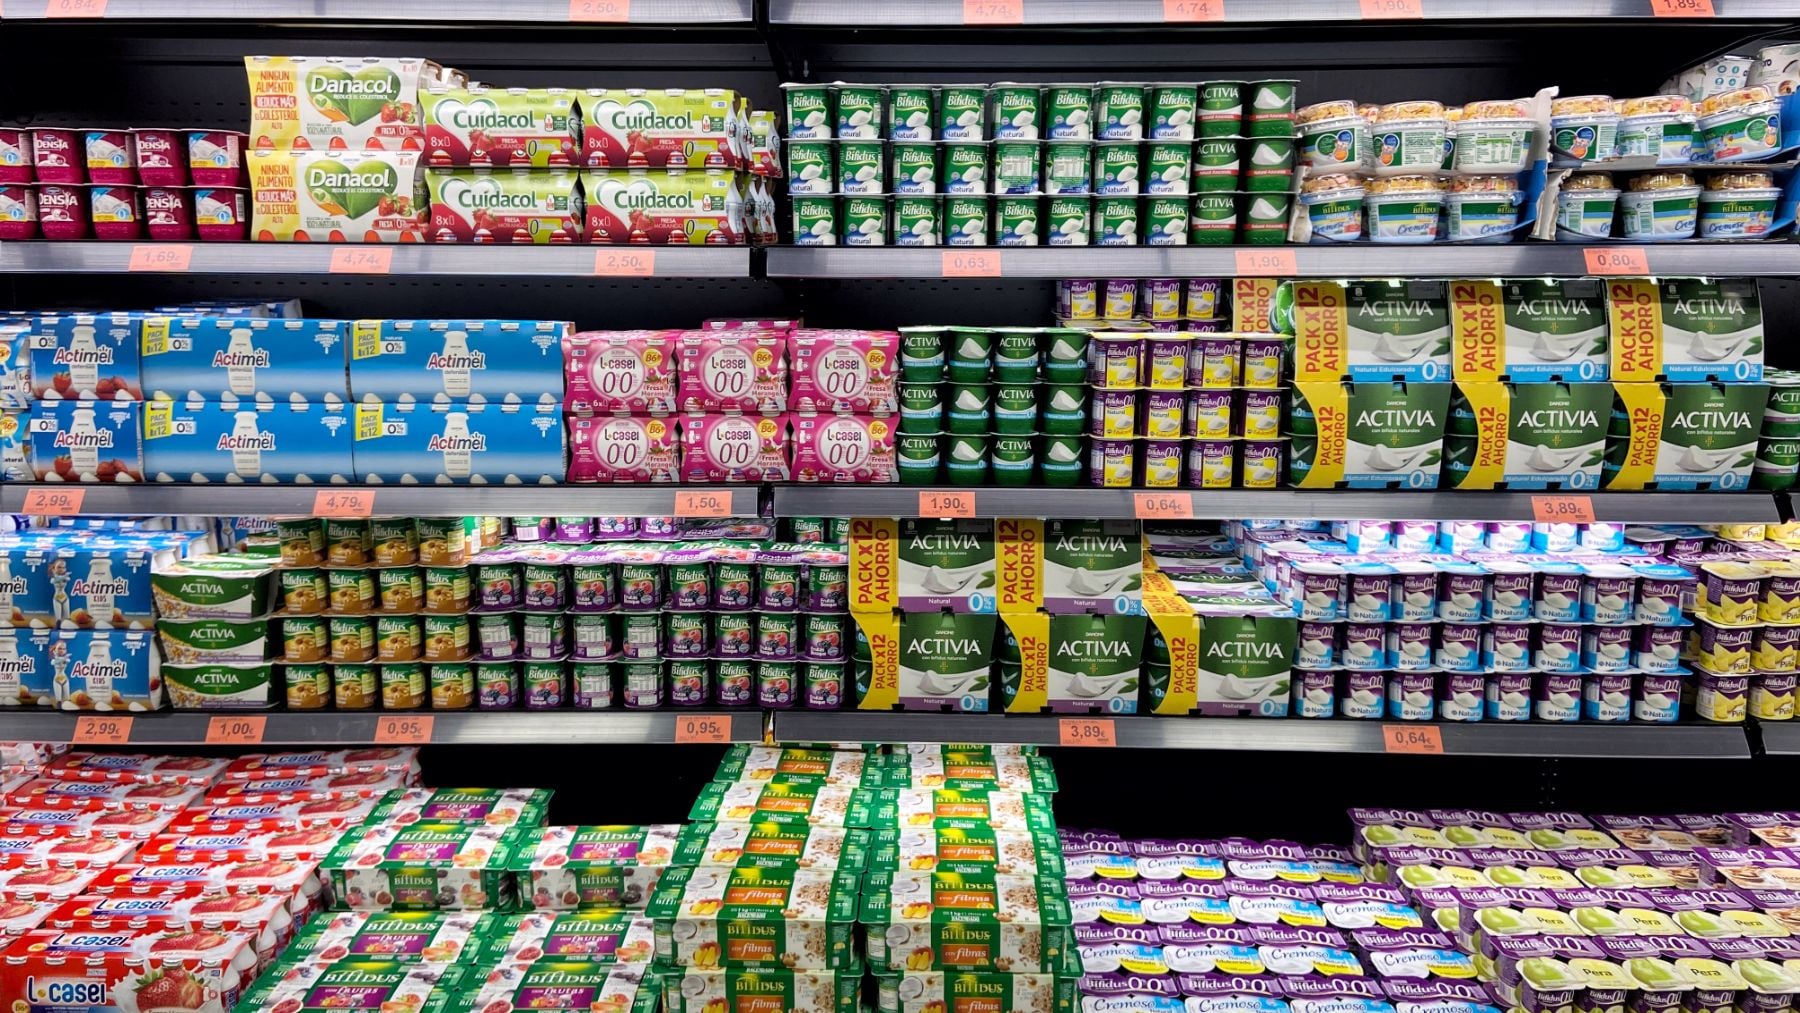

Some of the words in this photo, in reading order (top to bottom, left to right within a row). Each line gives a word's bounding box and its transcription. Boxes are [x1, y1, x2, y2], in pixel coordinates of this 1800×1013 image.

[256, 82, 294, 93] ALIMENTO
[1201, 87, 1239, 103] ACTIVIA
[794, 94, 825, 107] Bifidus
[897, 95, 928, 108] Bifidus
[1003, 93, 1034, 107] Bifidus
[1111, 93, 1142, 107] Bifidus
[453, 109, 537, 130] Cuidacol
[611, 110, 694, 131] Cuidacol
[896, 131, 920, 140] Natural
[1108, 130, 1132, 139] Natural
[846, 149, 876, 162] Bifidus
[953, 151, 983, 163] Bifidus
[1107, 151, 1137, 164] Bifidus
[1197, 143, 1236, 158] ACTIVIA
[257, 176, 293, 187] ALIMENTO
[458, 189, 538, 209] Cuidacol
[614, 190, 695, 210] Cuidacol
[1359, 300, 1434, 317] ACTIVIA
[1516, 299, 1591, 316] ACTIVIA
[1673, 299, 1746, 316] ACTIVIA
[1321, 295, 1340, 372] AHORRO
[1480, 293, 1497, 372] AHORRO
[1638, 292, 1654, 371] AHORRO
[904, 336, 942, 348] ACTIVIA
[999, 337, 1037, 348] ACTIVIA
[1620, 327, 1636, 372] PACK
[54, 346, 112, 364] Actimel
[213, 349, 268, 367] Actimel
[1305, 328, 1321, 373] PACK
[1463, 329, 1478, 373] PACK
[428, 352, 484, 369] Actimel
[1354, 365, 1377, 373] Natural
[1693, 365, 1729, 373] Edulcorado
[1355, 409, 1437, 427] ACTIVIA
[1517, 410, 1600, 428] ACTIVIA
[1670, 411, 1752, 428] ACTIVIA
[54, 432, 112, 448] Actimel
[217, 434, 274, 450] Actimel
[429, 435, 484, 451] Actimel
[901, 438, 938, 451] ACTIVIA
[1332, 412, 1346, 465] AHORRO
[1493, 413, 1508, 466] AHORRO
[1644, 413, 1661, 466] AHORRO
[1320, 430, 1332, 467] PACK
[1480, 431, 1492, 467] PACK
[1631, 432, 1643, 467] PACK
[909, 535, 981, 553] ACTIVIA
[1056, 536, 1128, 553] ACTIVIA
[875, 529, 890, 603] AHORRO
[1020, 528, 1036, 604] AHORRO
[481, 570, 509, 582] Bifidus
[677, 571, 705, 583] Bifidus
[766, 570, 794, 582] Bifidus
[858, 560, 873, 604] PACK
[1003, 559, 1018, 604] PACK
[73, 580, 127, 596] Actimel
[181, 582, 224, 594] ACTIVIA
[928, 597, 951, 605] Natural
[1073, 599, 1097, 607] Natural
[1310, 609, 1334, 618] Natural
[1500, 609, 1525, 617] Natural
[1645, 614, 1672, 624] Natural
[672, 619, 700, 631] Bifidus
[190, 628, 236, 640] ACTIVIA
[907, 637, 982, 655] ACTIVIA
[1056, 640, 1132, 657] ACTIVIA
[1206, 641, 1285, 659] ACTIVIA
[73, 663, 126, 679] Actimel
[876, 656, 889, 689] PACK
[887, 640, 898, 690] AHORRO
[1036, 642, 1048, 691] AHORRO
[1185, 643, 1198, 693] AHORRO
[194, 673, 240, 685] ACTIVIA
[810, 668, 838, 681] Bifidus
[1024, 662, 1035, 692] PACK
[1173, 662, 1184, 694] PACK
[1453, 873, 1476, 882] Pera
[951, 894, 990, 903] fibras
[1153, 900, 1208, 911] Cremoso
[1536, 916, 1564, 925] Pera
[1633, 917, 1661, 926] Pera
[1075, 930, 1114, 938] Bifidus
[741, 943, 772, 957] fibras
[955, 947, 987, 958] fibras
[1500, 940, 1545, 950] Bifidus
[1271, 948, 1329, 960] Cremoso
[1384, 951, 1440, 966] Cremoso
[1583, 968, 1613, 977] Pera
[1691, 968, 1722, 978] Pera
[1086, 980, 1129, 989] Bifidus
[1289, 981, 1332, 991] Bifidus
[1094, 998, 1154, 1011] Cremoso
[1199, 999, 1261, 1012] Cremoso
